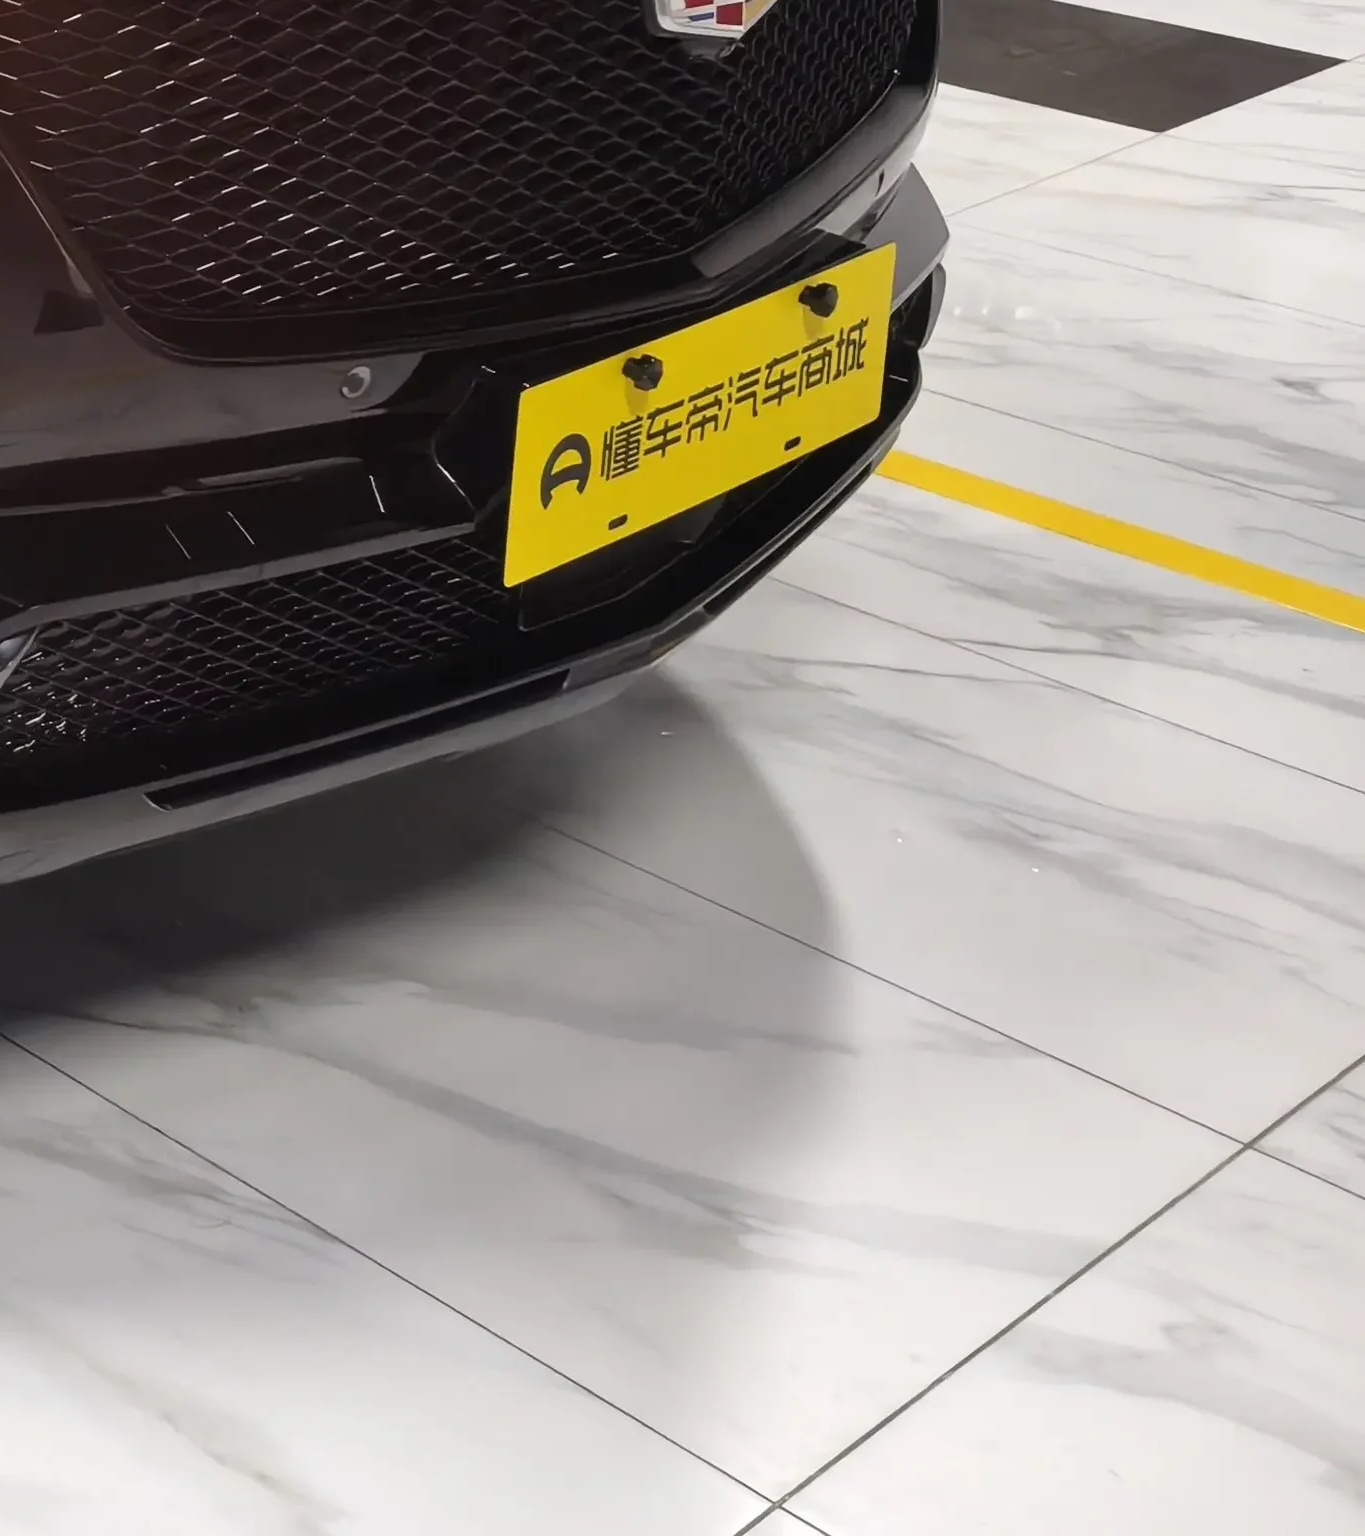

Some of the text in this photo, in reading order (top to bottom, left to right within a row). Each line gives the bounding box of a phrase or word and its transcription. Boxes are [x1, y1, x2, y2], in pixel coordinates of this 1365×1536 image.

[600, 316, 869, 481] 懂车帝汽车商城
